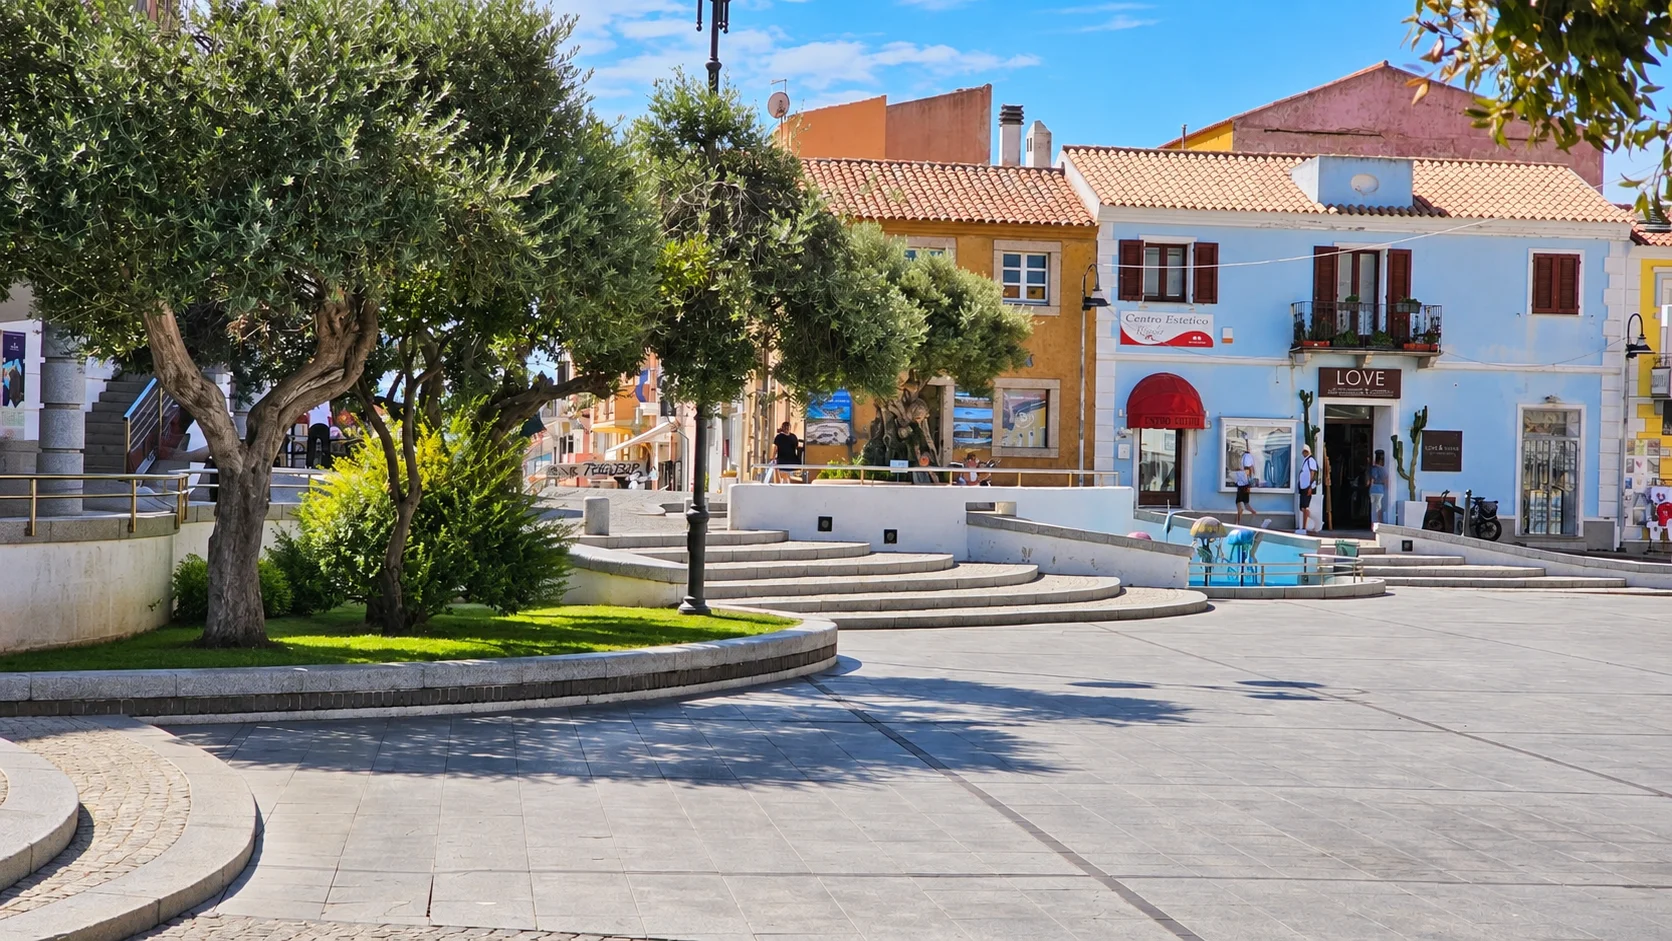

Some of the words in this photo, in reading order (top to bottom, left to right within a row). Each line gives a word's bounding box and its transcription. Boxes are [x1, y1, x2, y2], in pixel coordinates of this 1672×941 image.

[1125, 313, 1162, 324] Centro
[1165, 315, 1209, 326] Estetico
[1336, 369, 1385, 386] LOVE
